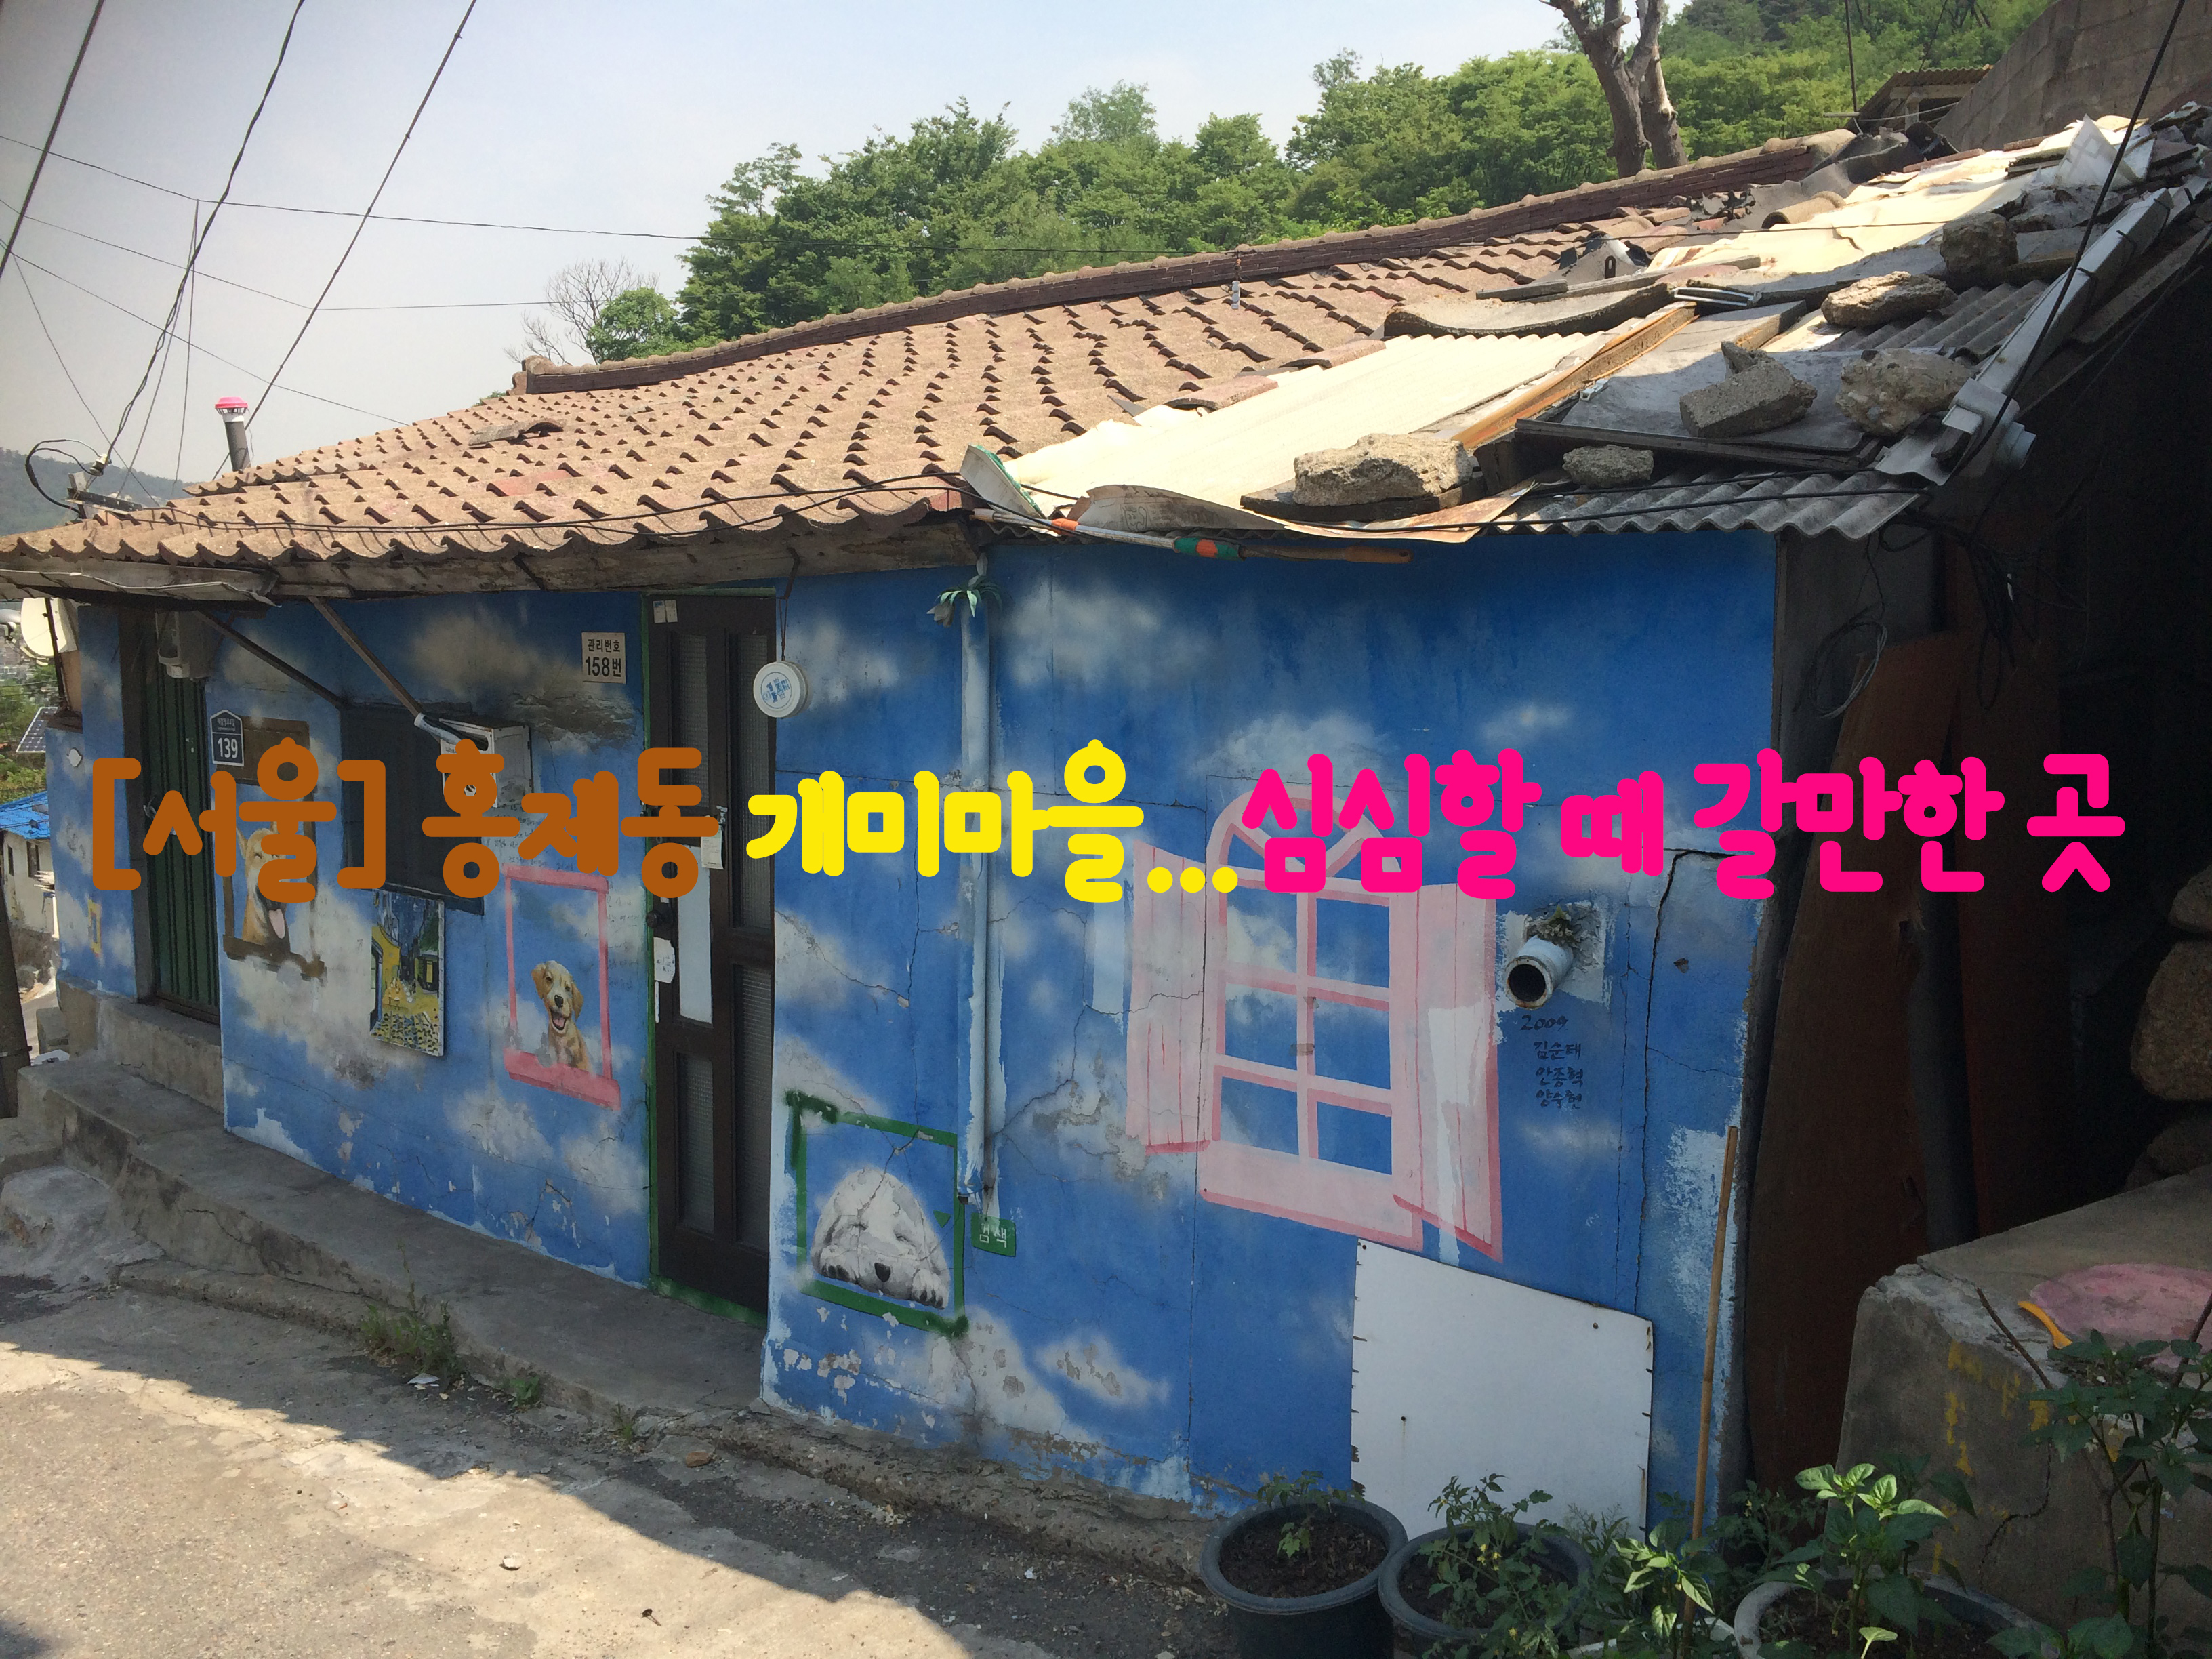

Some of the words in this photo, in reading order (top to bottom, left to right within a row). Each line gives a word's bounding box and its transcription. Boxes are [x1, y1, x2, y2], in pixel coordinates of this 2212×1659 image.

[588, 639, 621, 653] 관리번호
[585, 656, 621, 677] 158번
[218, 737, 238, 759] 139
[1533, 1040, 1582, 1061] 김순태
[1535, 1066, 1584, 1088] 안종혁
[1535, 1088, 1582, 1109] 양수현
